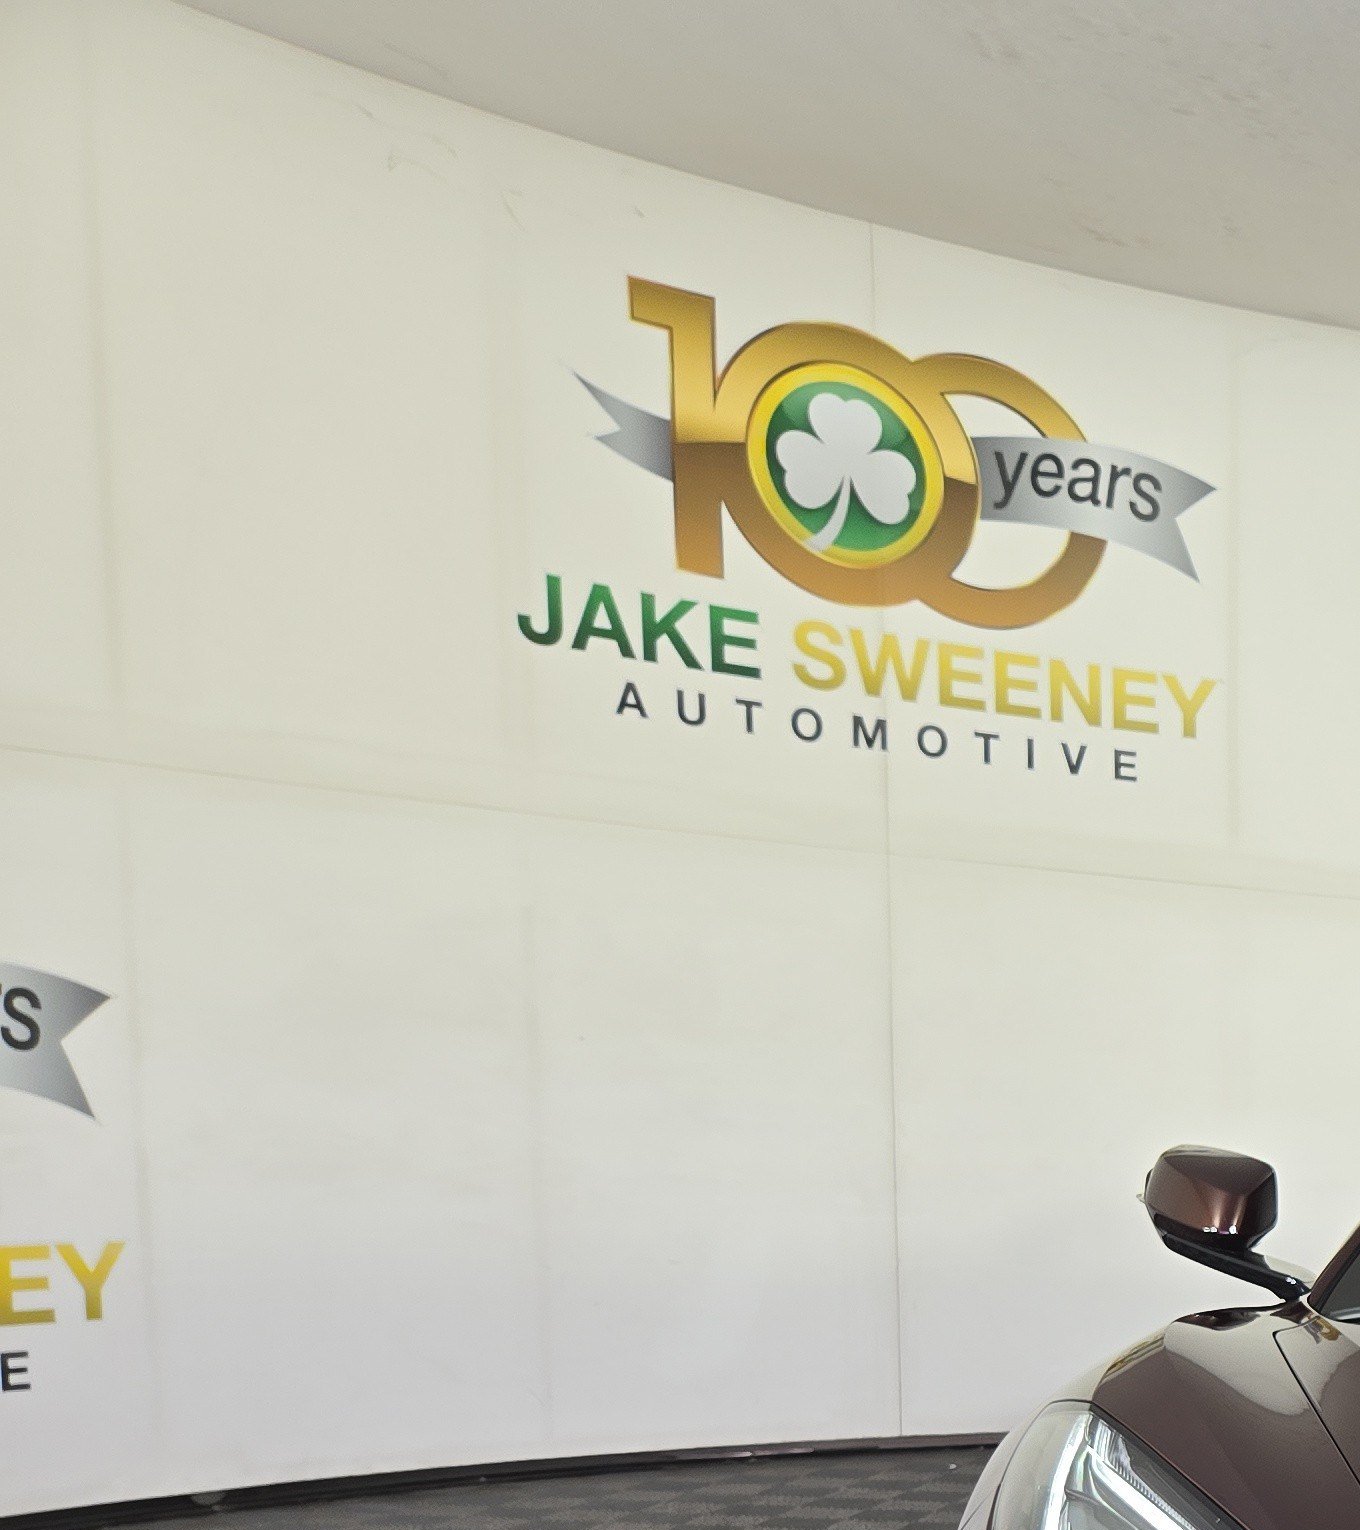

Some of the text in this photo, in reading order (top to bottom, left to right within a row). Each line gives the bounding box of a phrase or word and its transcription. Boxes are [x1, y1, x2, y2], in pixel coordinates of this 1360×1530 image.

[992, 448, 1163, 523] years
[517, 573, 1218, 739] JAKE SWEENEY
[616, 681, 1138, 783] AUTOMOTIVE
